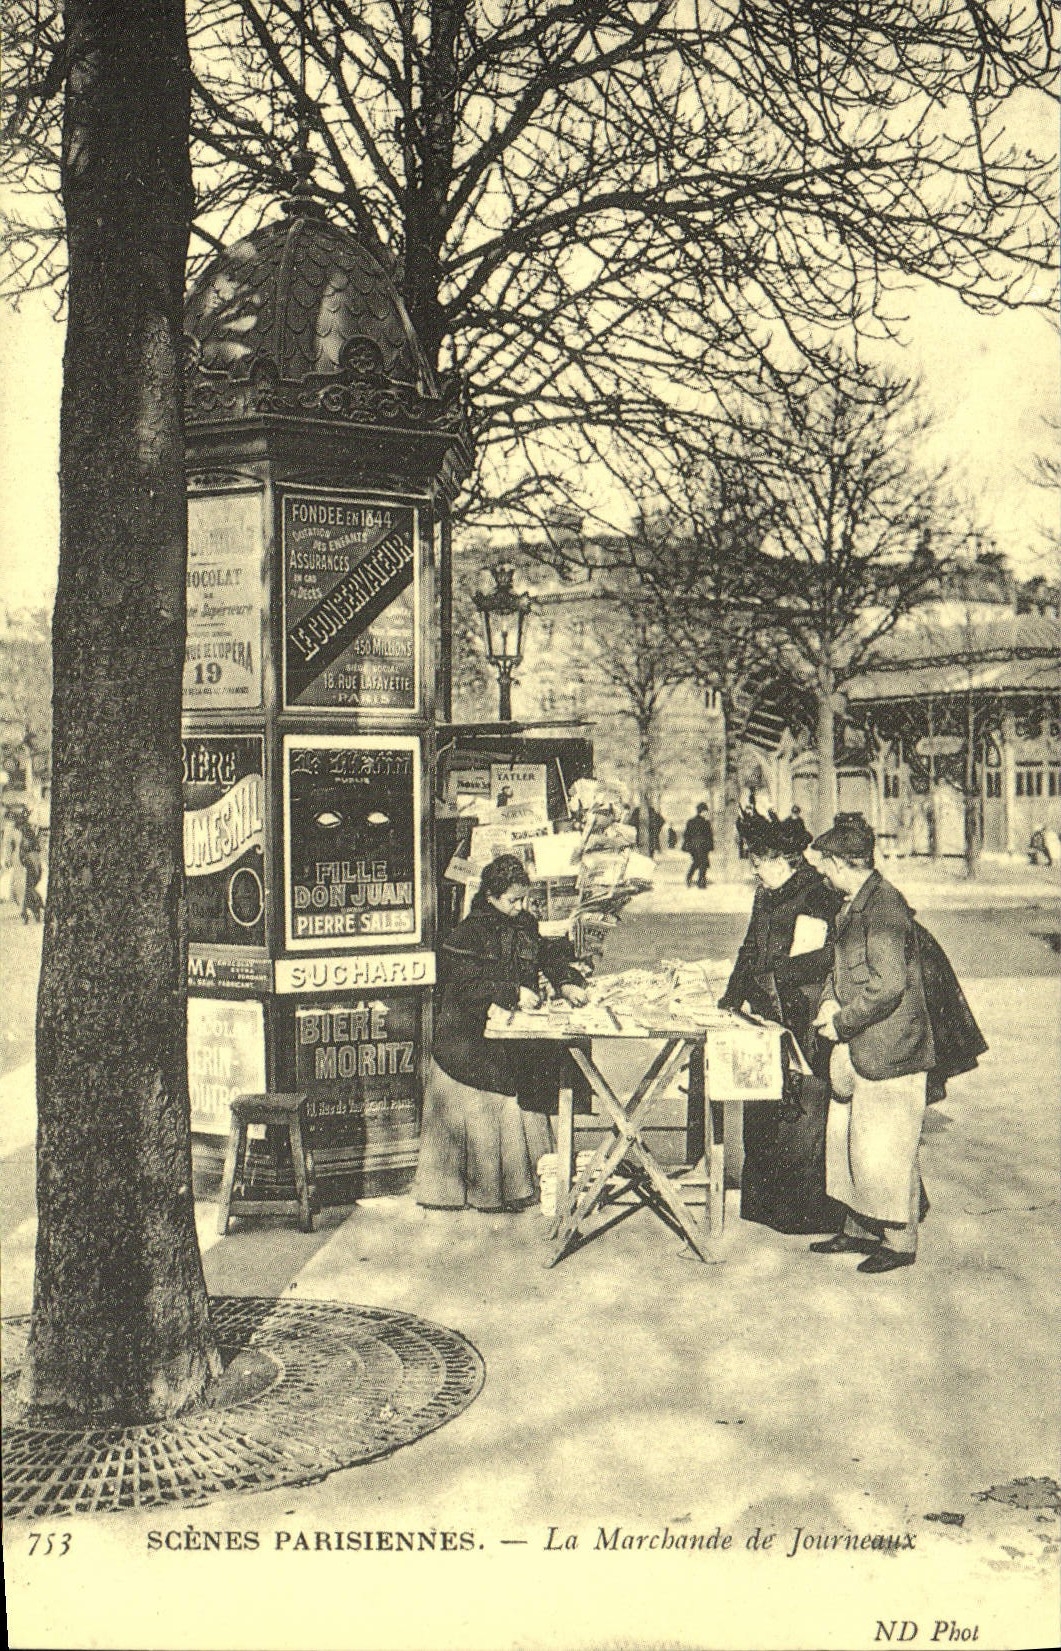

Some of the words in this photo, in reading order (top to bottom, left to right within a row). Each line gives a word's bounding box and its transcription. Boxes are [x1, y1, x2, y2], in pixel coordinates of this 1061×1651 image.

[346, 510, 359, 526] EN
[361, 509, 392, 528] 1844
[328, 532, 368, 551] ENFANTS
[289, 549, 350, 573] ASSURANCES
[186, 568, 242, 587] OCOLAT
[289, 628, 321, 662] LE
[307, 534, 414, 645] CONSERVATEUR
[353, 638, 371, 655] 450
[372, 638, 413, 657] MILLIONS
[194, 662, 222, 685] 19
[338, 673, 358, 690] RUE
[360, 674, 410, 691] LAFAYETTE
[338, 692, 391, 704] PARIS
[497, 772, 536, 782] TATLER
[316, 860, 388, 884] FILLE
[293, 883, 346, 909] DON
[350, 882, 412, 906] JUAN
[297, 913, 356, 935] PIERRE
[360, 909, 412, 932] SALES
[291, 961, 427, 988] SUCHARD
[315, 1041, 414, 1079] MORITZ
